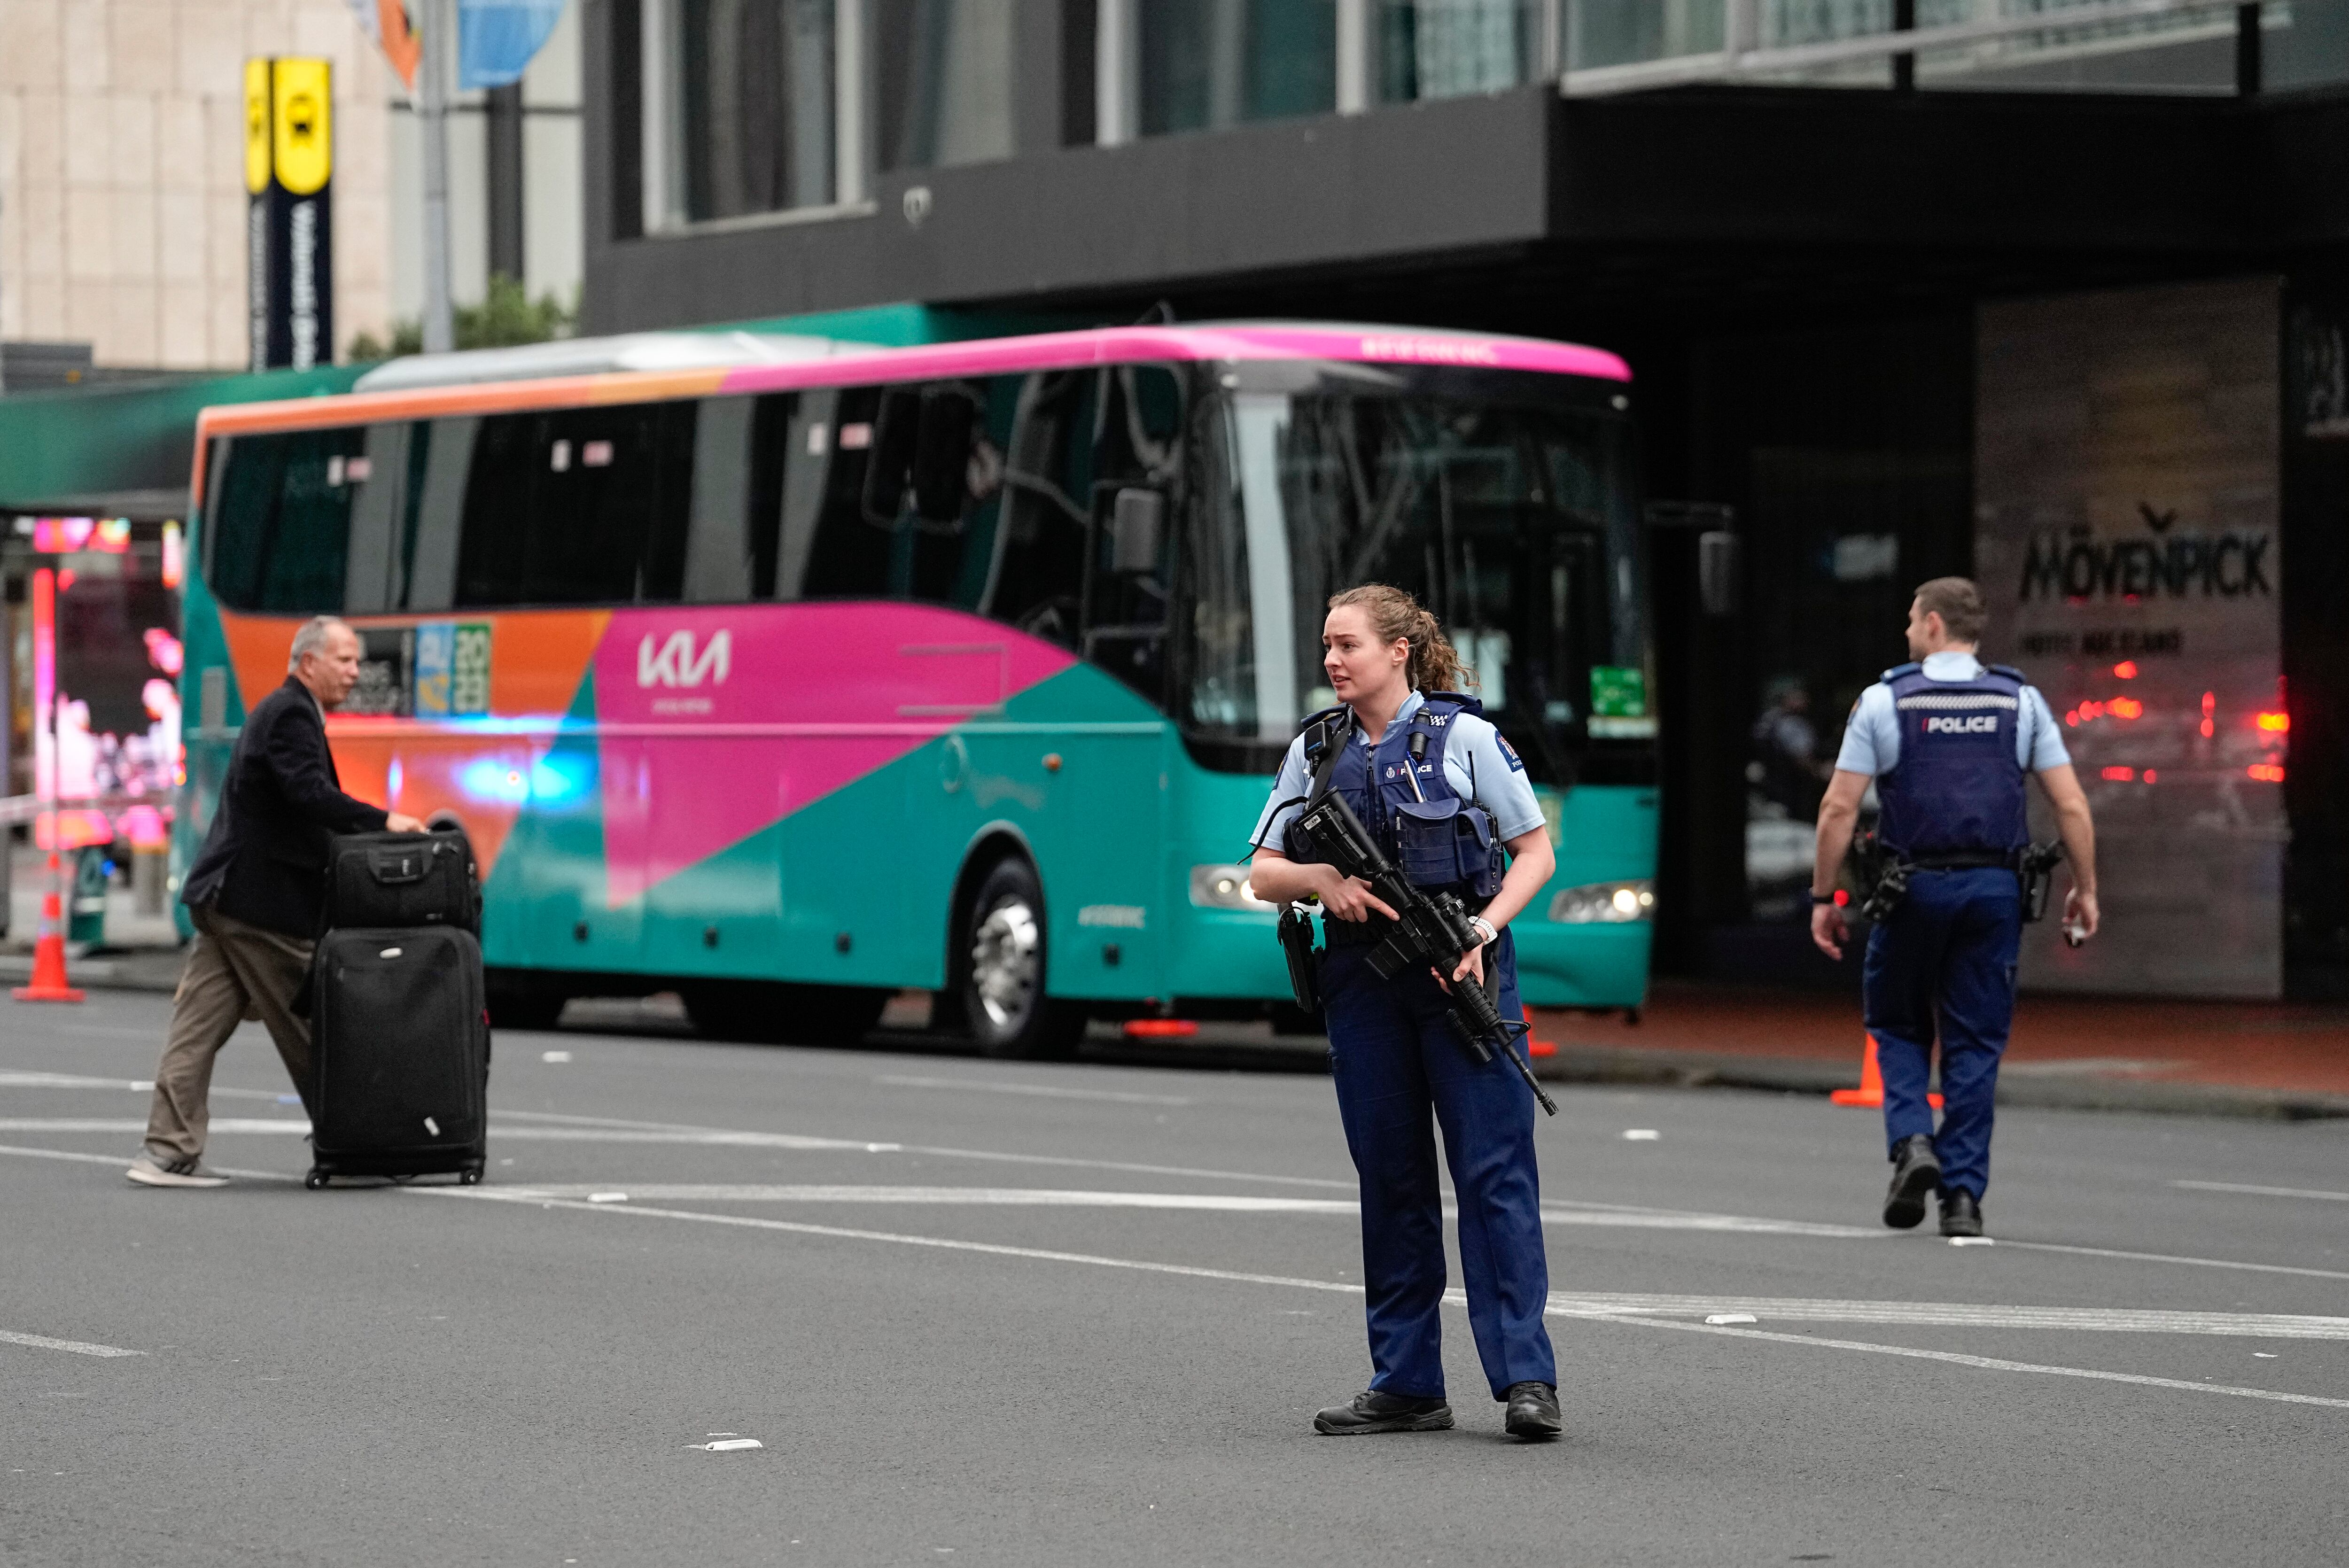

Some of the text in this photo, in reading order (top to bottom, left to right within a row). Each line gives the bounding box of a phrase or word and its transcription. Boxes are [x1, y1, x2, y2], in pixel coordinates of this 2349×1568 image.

[2020, 523, 2270, 602] MÖVENPICK
[638, 629, 731, 688] KIA
[1927, 716, 1998, 734] POLICE
[1400, 764, 1432, 776] PICE
